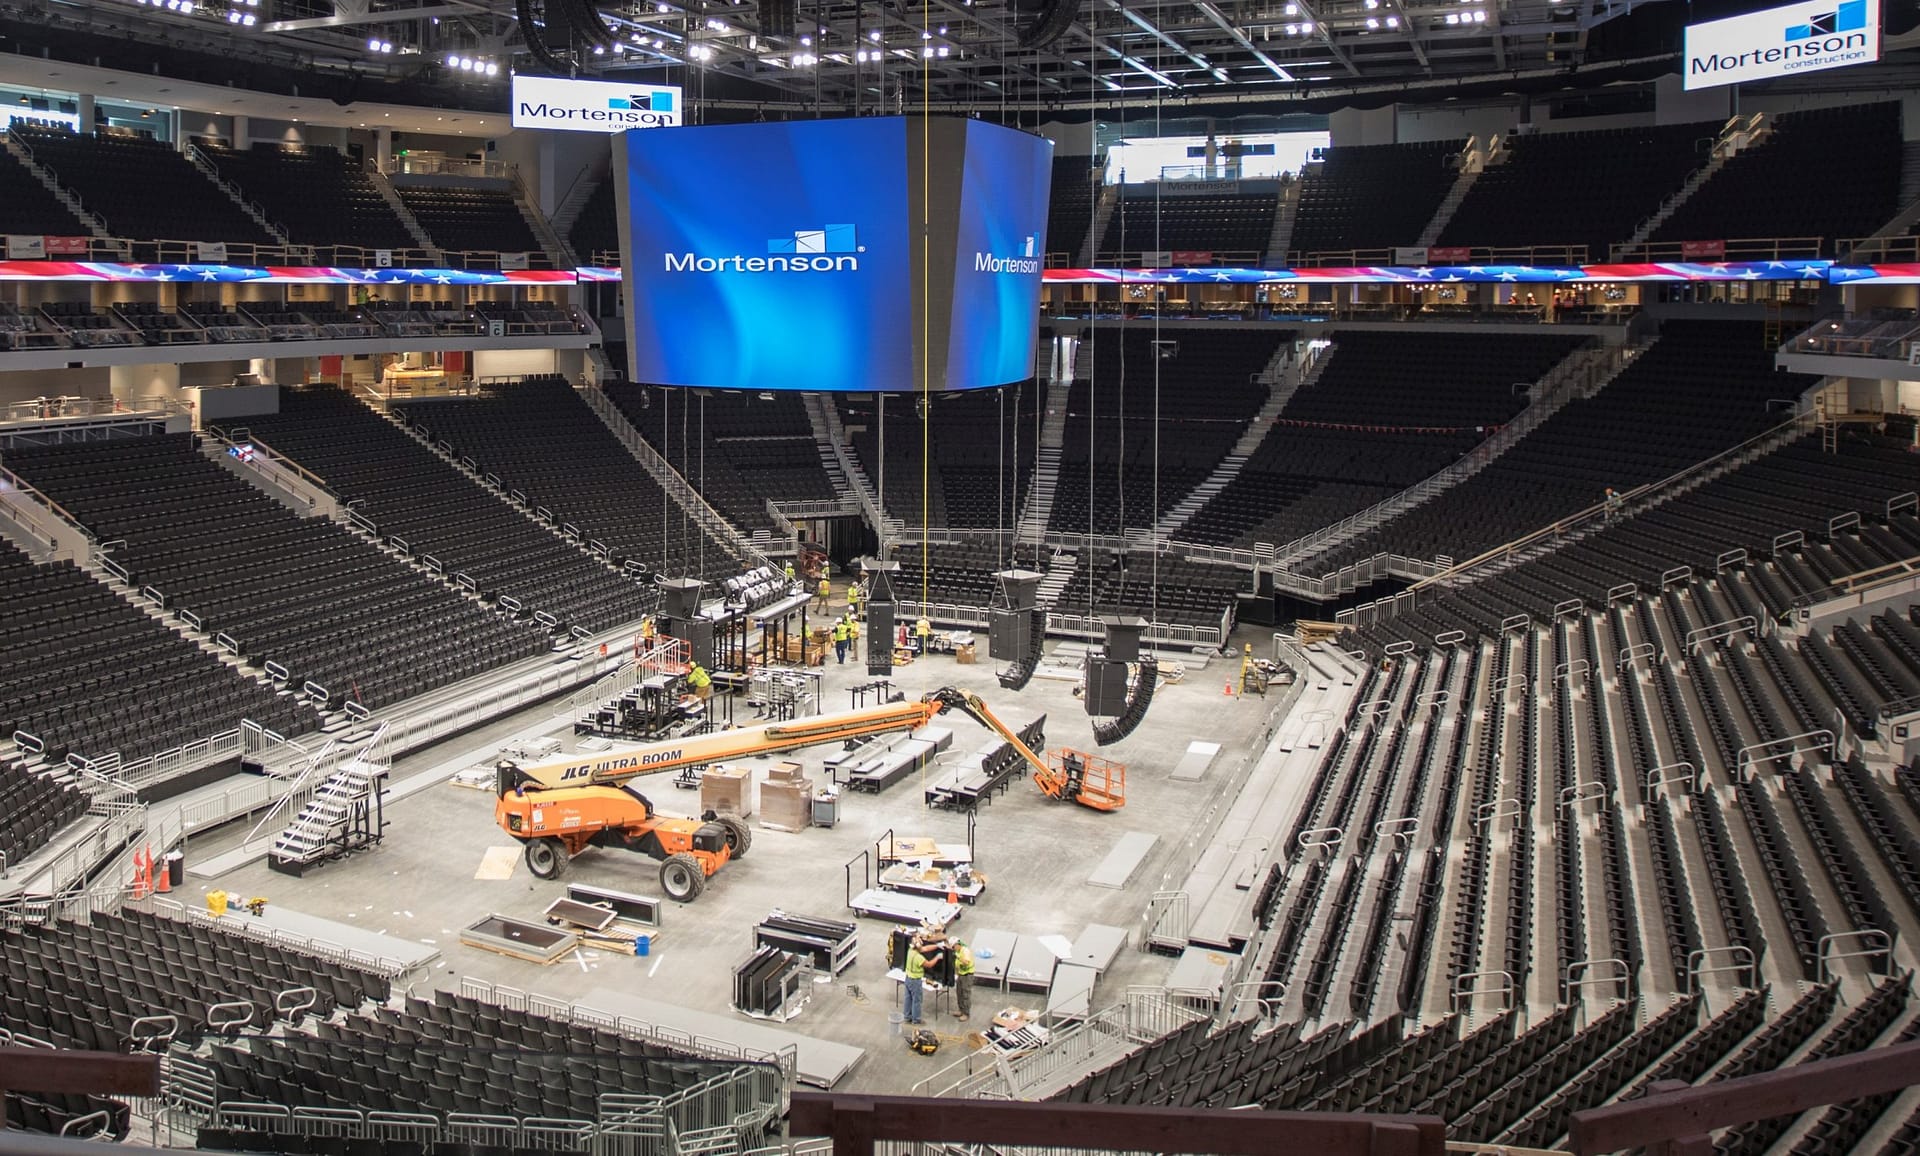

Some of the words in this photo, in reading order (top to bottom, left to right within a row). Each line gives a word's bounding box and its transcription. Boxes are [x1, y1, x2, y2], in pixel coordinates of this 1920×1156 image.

[1692, 32, 1866, 75] Mortenson
[1784, 51, 1867, 70] construction
[520, 102, 673, 125] Mortenson
[665, 253, 858, 272] Mortenson
[975, 252, 1038, 273] Mortenson
[560, 765, 590, 780] JLG
[597, 757, 638, 771] ULTRA
[642, 750, 682, 765] BOOM
